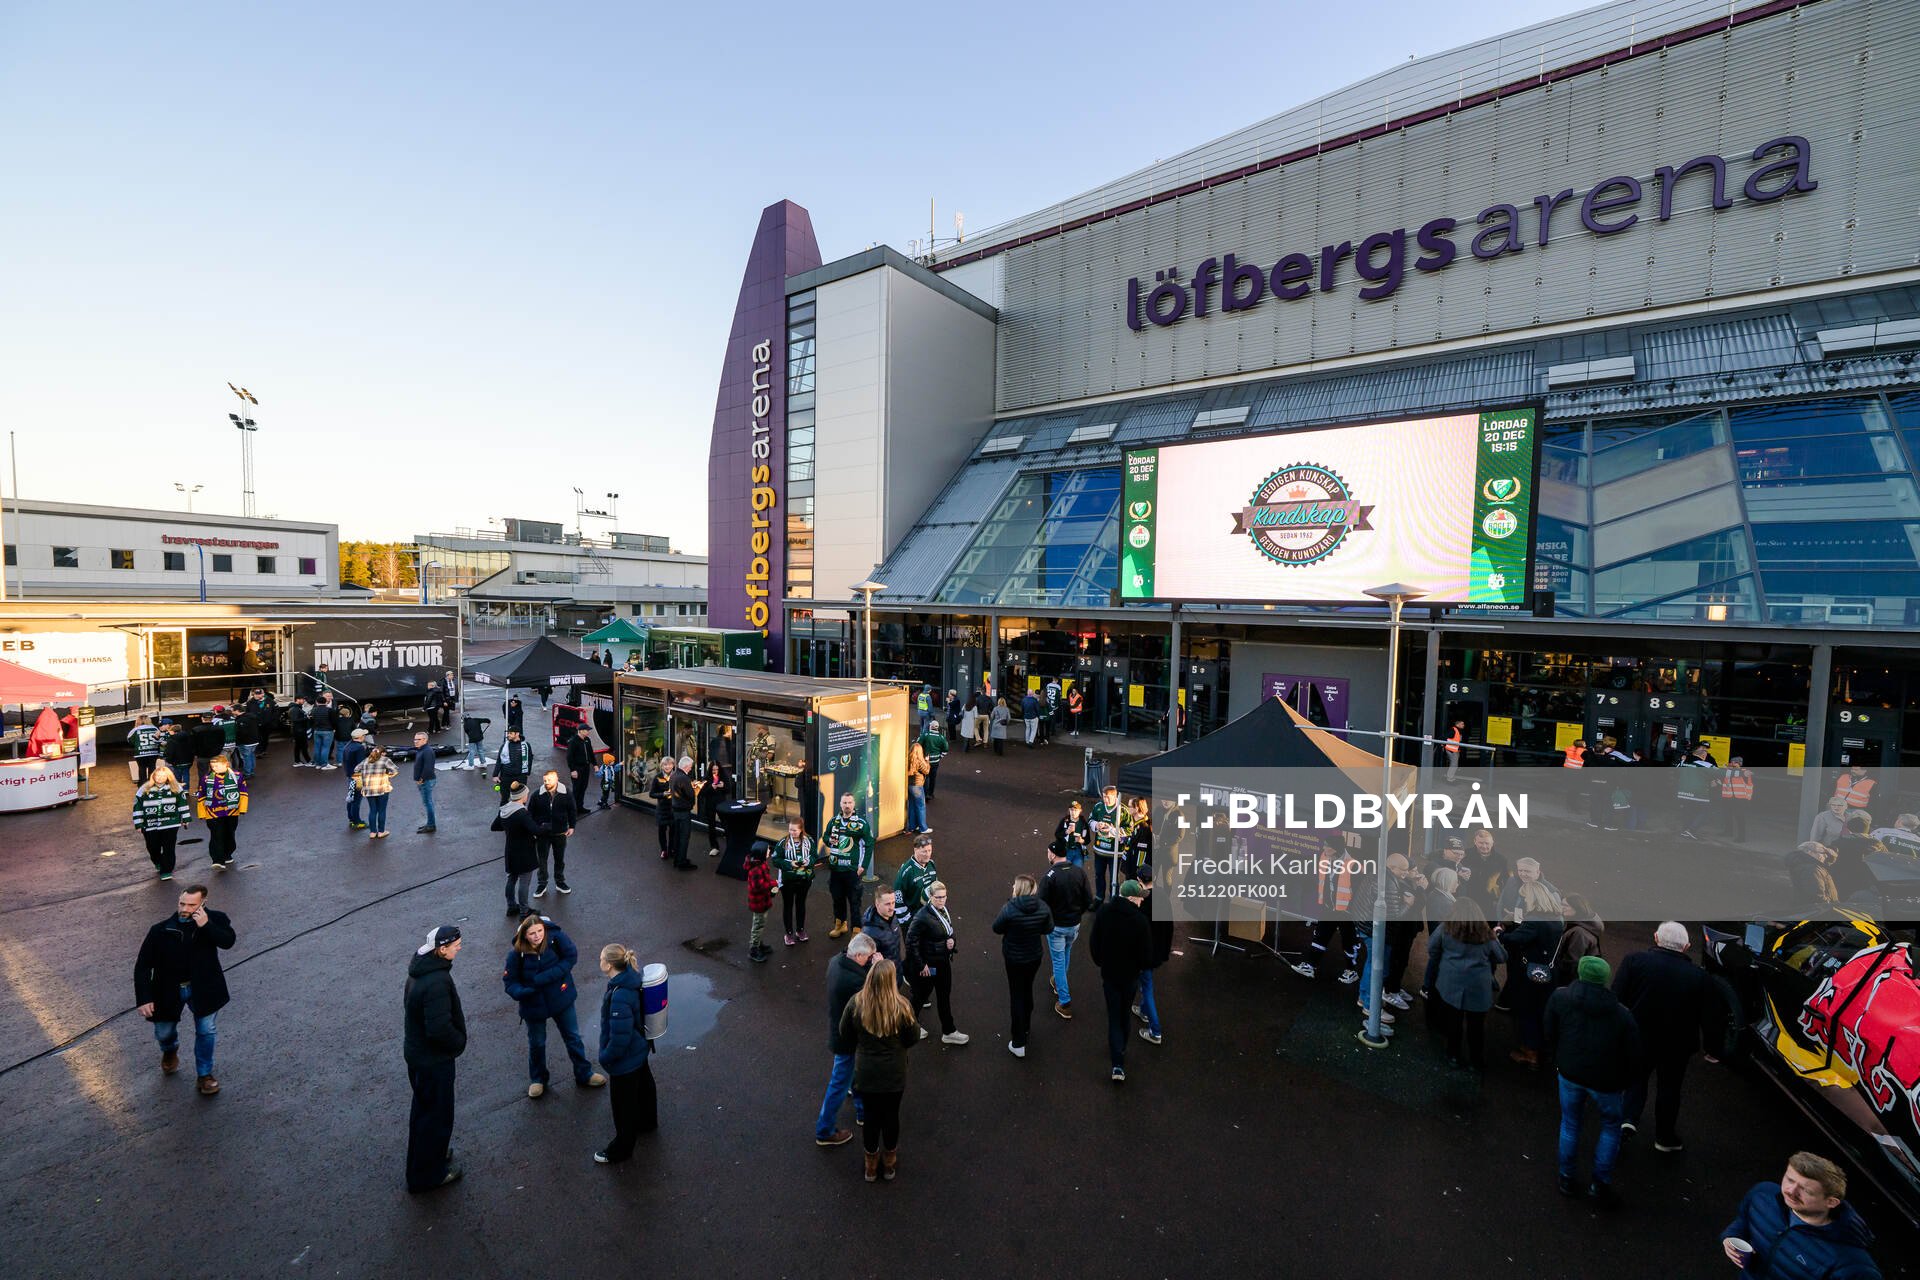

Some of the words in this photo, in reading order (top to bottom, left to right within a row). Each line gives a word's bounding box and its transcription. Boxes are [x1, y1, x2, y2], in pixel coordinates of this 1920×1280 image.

[1485, 432, 1500, 442] 20
[1502, 430, 1526, 441] DEC
[1491, 441, 1518, 453] 15:15
[1140, 465, 1154, 473] DEC
[1260, 471, 1296, 499] GEDIGEN
[1300, 469, 1341, 495] KUNSKAP
[1252, 502, 1347, 528] Kundskap
[1299, 531, 1313, 539] 1962
[1259, 534, 1290, 560] GEDIGEN
[2, 640, 35, 652] EB
[735, 648, 752, 656] SEB
[1008, 652, 1014, 661] 2
[314, 647, 391, 672] IMPACT
[395, 645, 443, 668] TOUR
[1105, 659, 1112, 668] 4
[1191, 665, 1198, 674] 5
[571, 674, 586, 684] TOUR
[1449, 683, 1458, 693] 6
[1596, 694, 1606, 705] 7
[1649, 697, 1660, 709] 8
[1839, 710, 1852, 723] 9
[30, 774, 46, 785] på
[49, 769, 75, 781] riktigt
[1232, 786, 1247, 794] SHL
